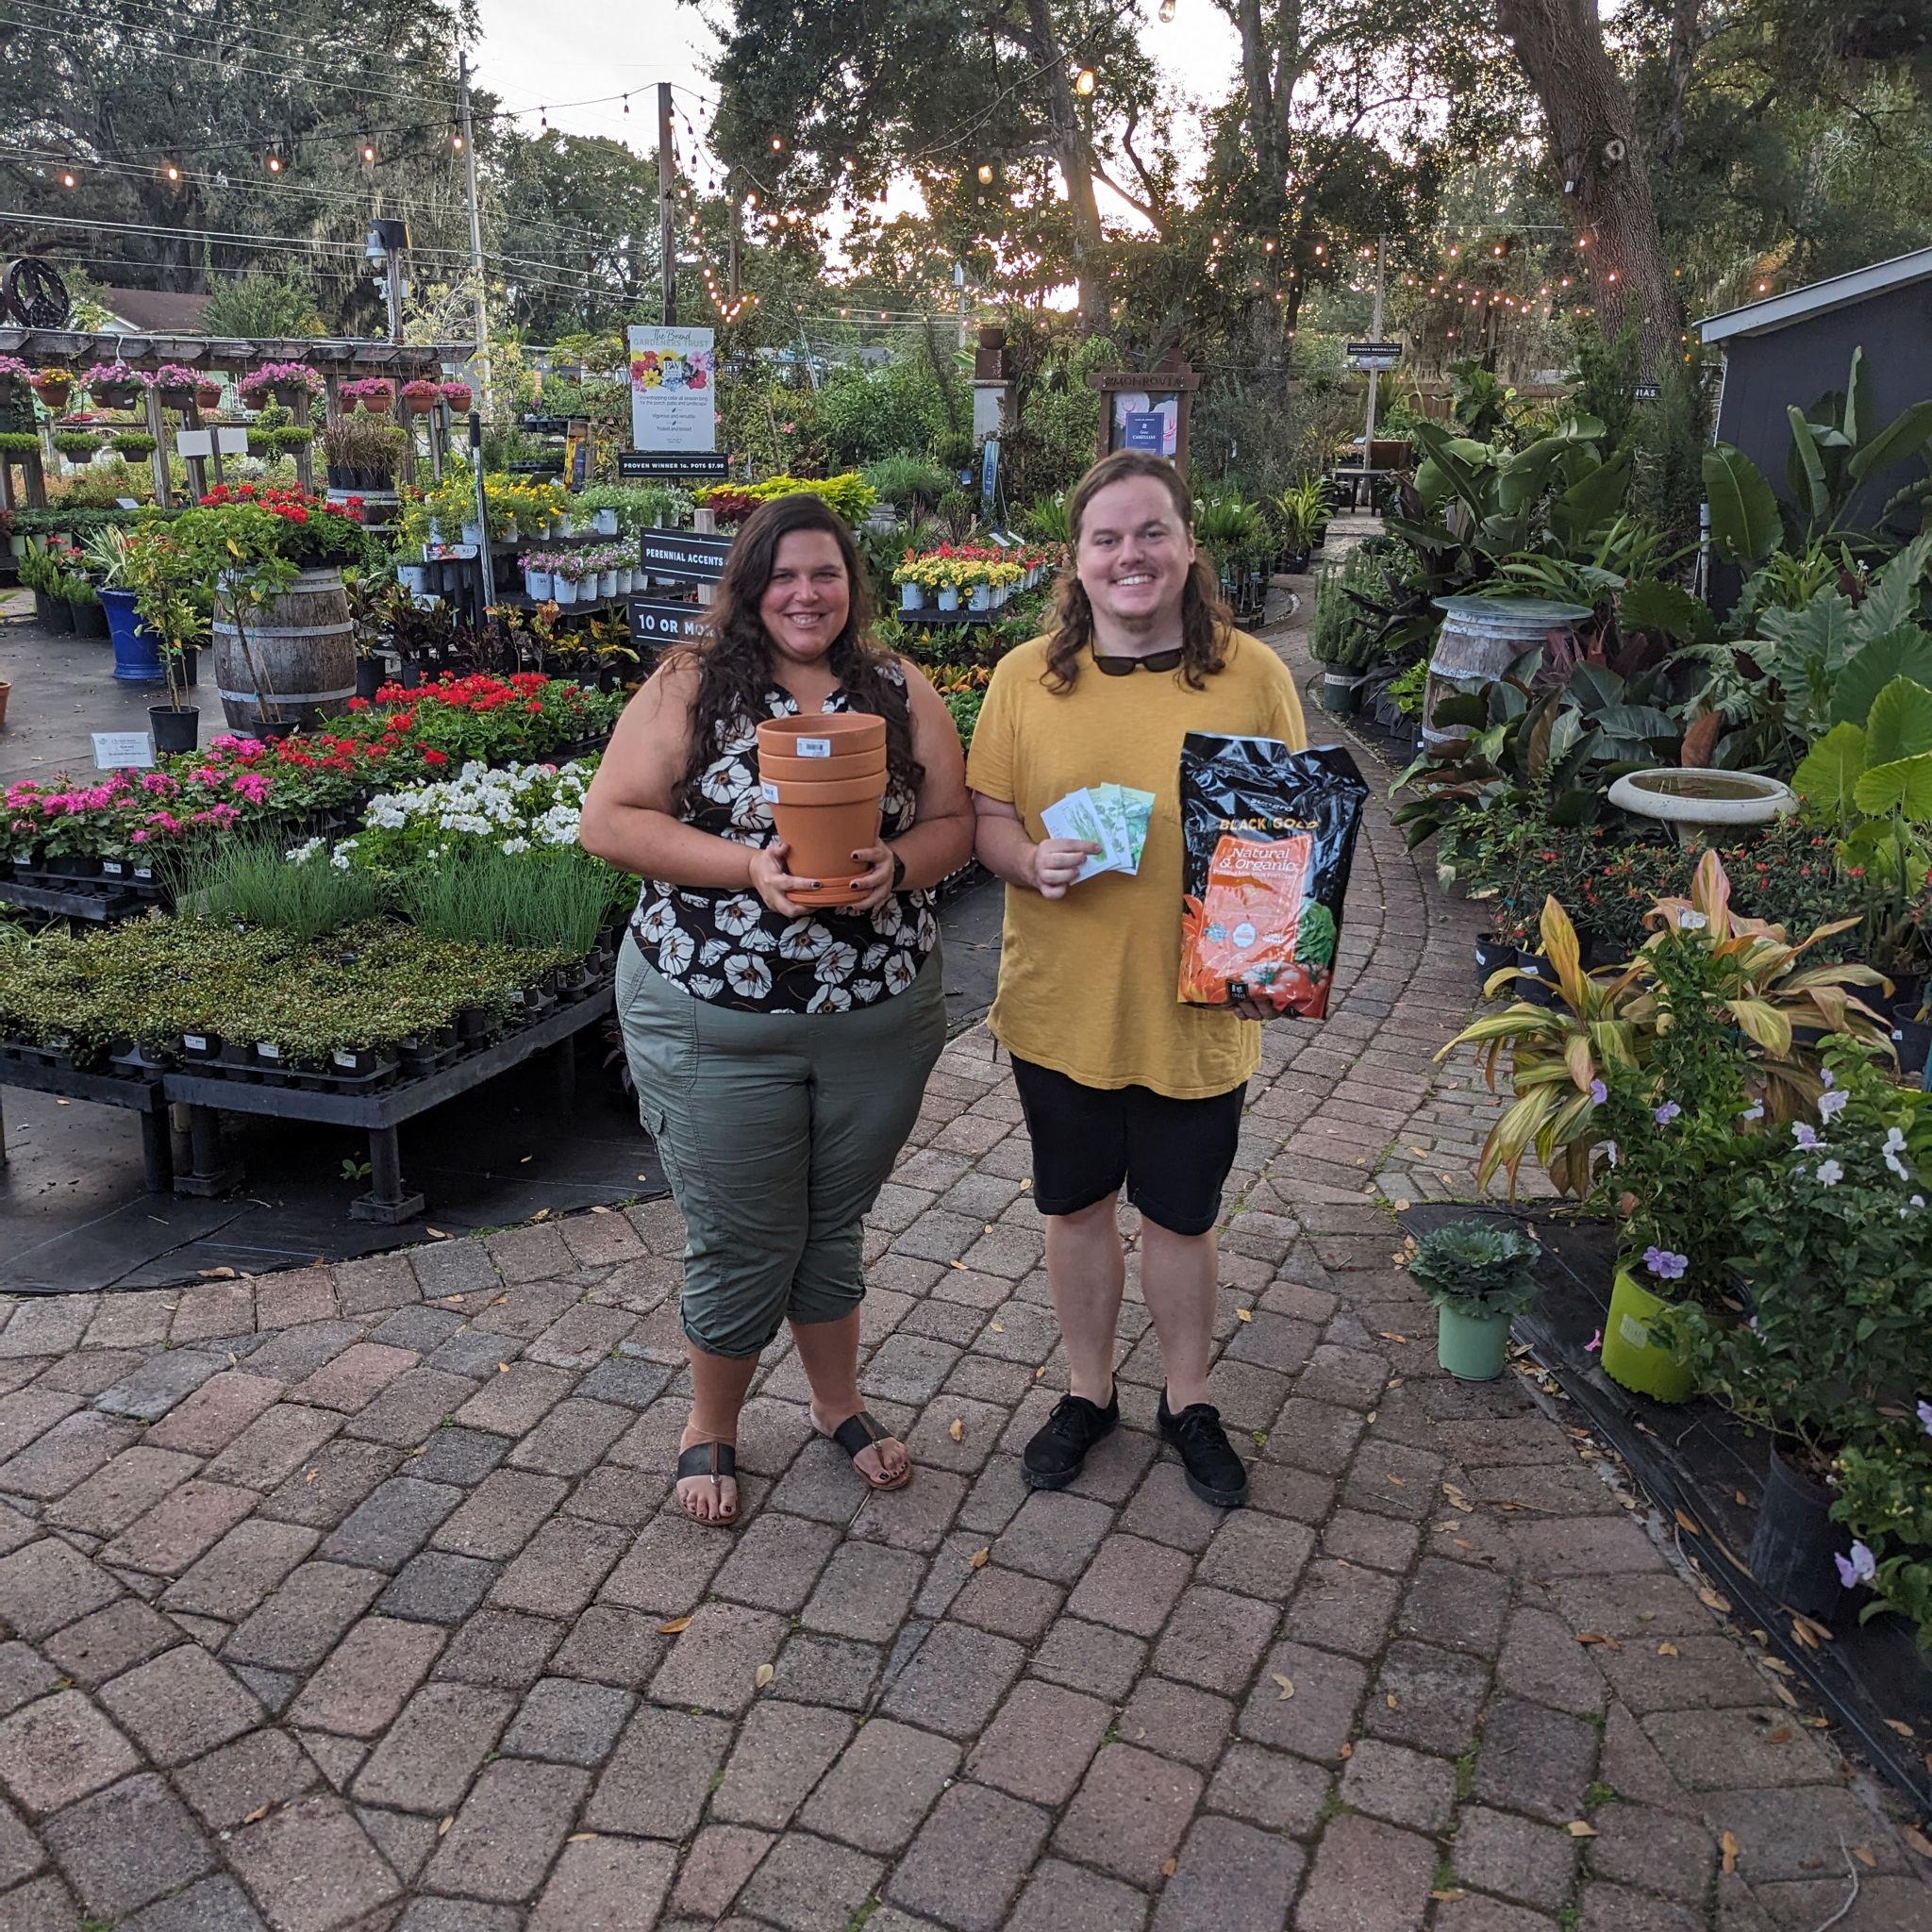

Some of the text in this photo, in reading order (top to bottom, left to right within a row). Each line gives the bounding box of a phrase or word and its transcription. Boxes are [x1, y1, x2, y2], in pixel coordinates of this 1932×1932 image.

[653, 328, 691, 341] The Brand
[633, 339, 708, 348] GARDENERS TRUST
[645, 548, 686, 562] PERENNIAL
[688, 554, 724, 566] ACCENTS
[639, 614, 655, 630] 10
[660, 619, 678, 633] OR
[1219, 817, 1319, 830] BLACK GOLD
[1229, 848, 1290, 858] Natural
[1220, 858, 1296, 872] & Organic
